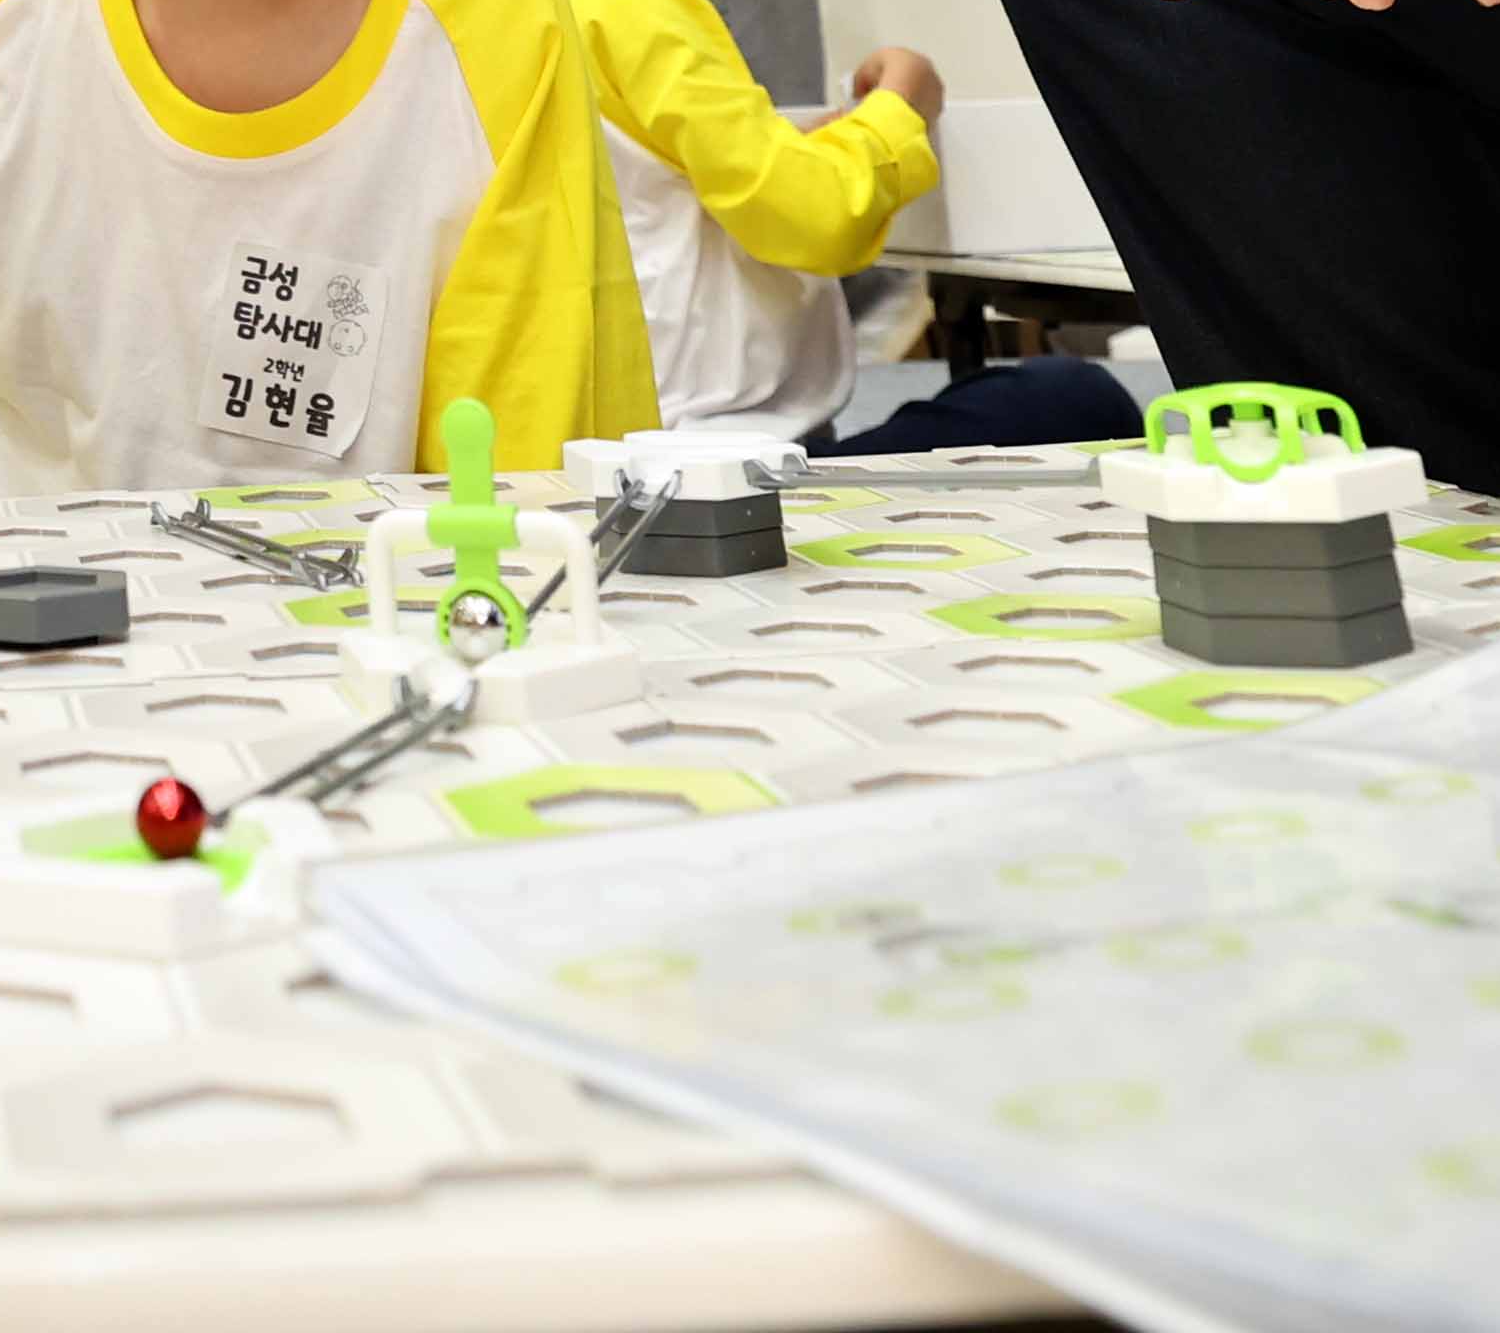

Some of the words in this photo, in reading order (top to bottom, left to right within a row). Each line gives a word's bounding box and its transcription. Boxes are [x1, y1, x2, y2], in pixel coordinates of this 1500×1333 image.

[240, 256, 300, 302] 금성
[233, 301, 323, 350] 탐사대
[263, 357, 305, 383] 2학년
